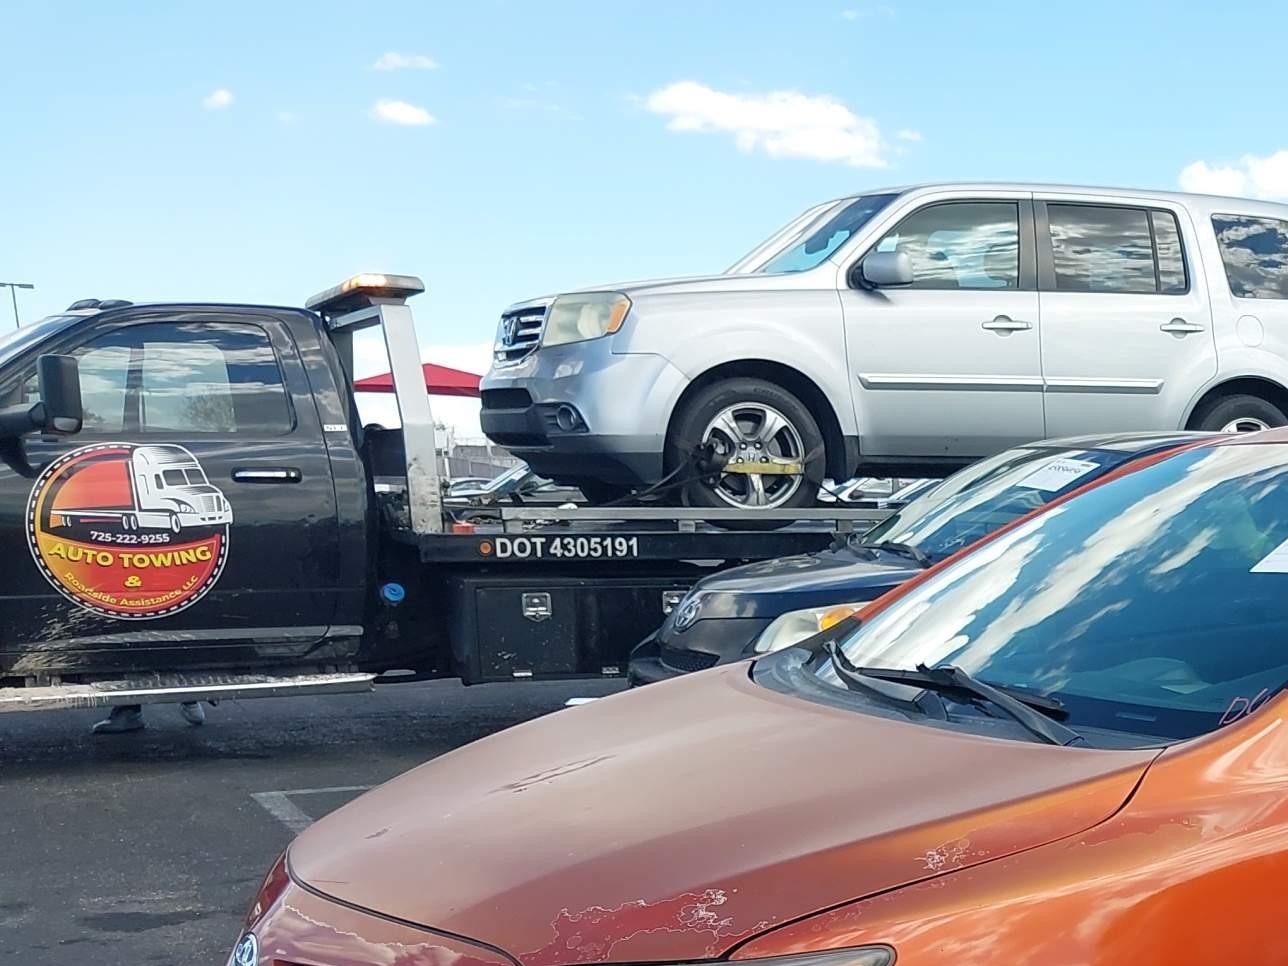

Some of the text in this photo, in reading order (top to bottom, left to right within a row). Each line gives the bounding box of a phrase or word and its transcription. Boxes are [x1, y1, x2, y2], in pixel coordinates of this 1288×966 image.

[90, 530, 170, 544] 725-222-9255
[495, 536, 638, 558] DOT 4305191
[49, 542, 212, 569] AUTO TOWING
[63, 572, 117, 604] Roadside
[119, 588, 182, 607] Assistance
[124, 575, 142, 588] &
